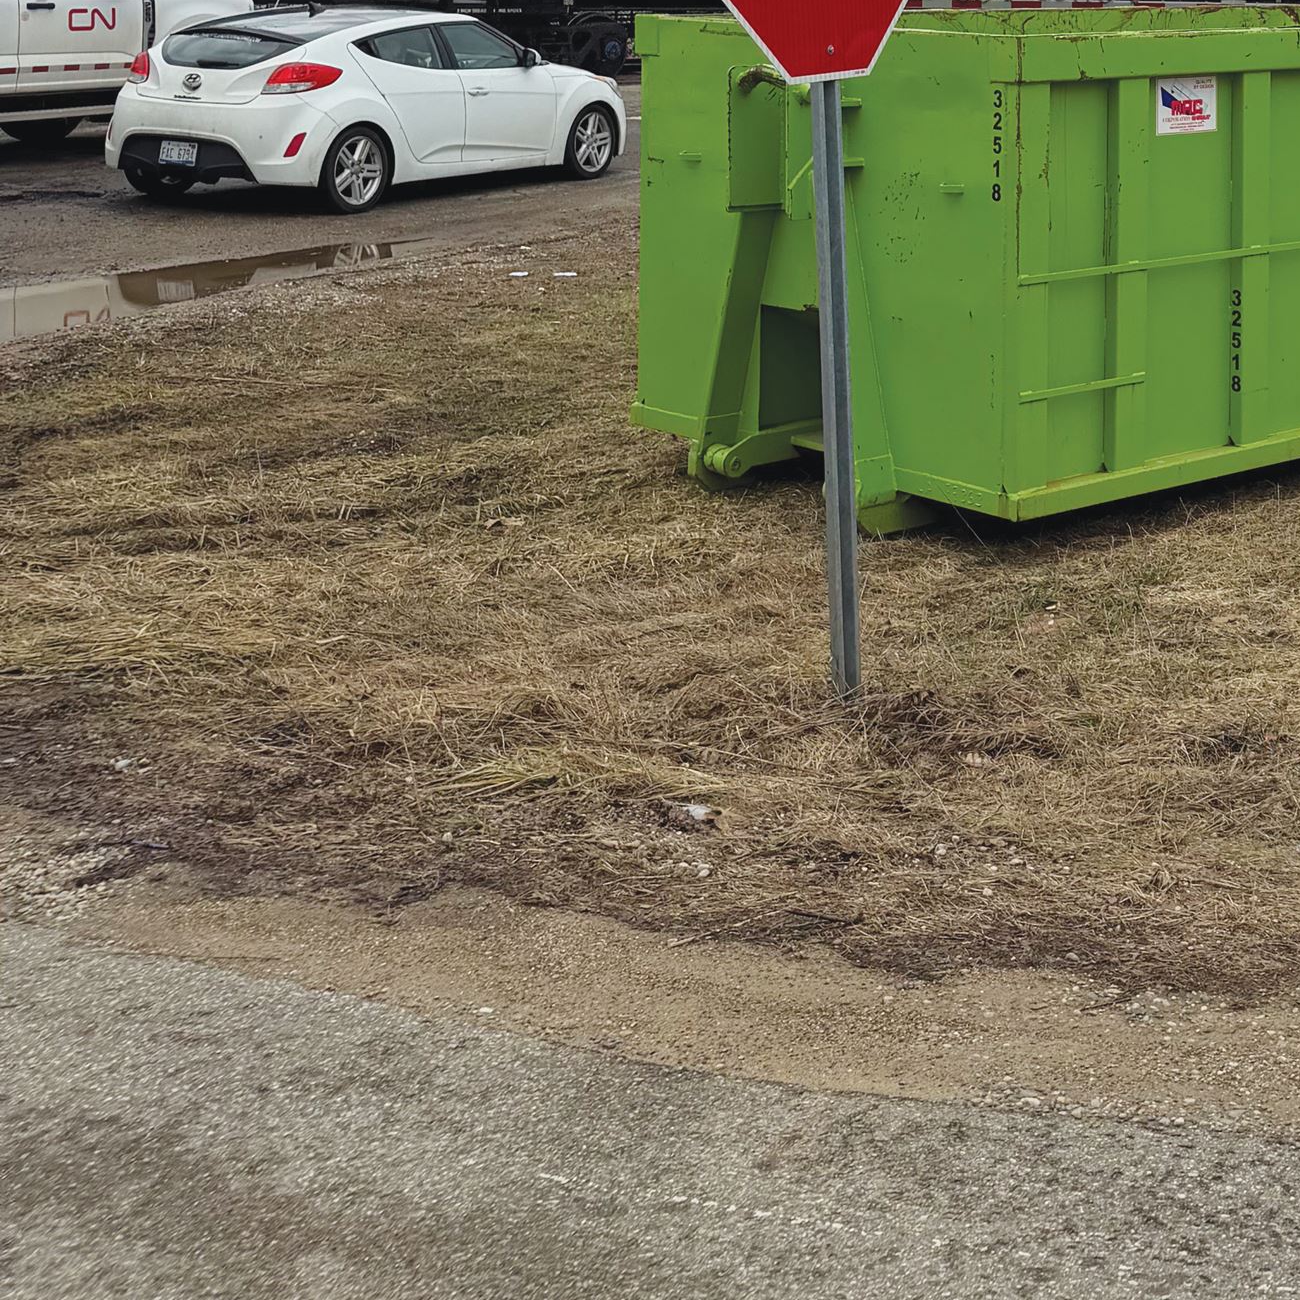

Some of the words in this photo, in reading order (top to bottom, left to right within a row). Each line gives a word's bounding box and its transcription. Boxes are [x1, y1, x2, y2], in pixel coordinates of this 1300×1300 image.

[68, 7, 116, 32] CN
[992, 89, 1002, 202] 32518
[1231, 289, 1242, 392] 32518
